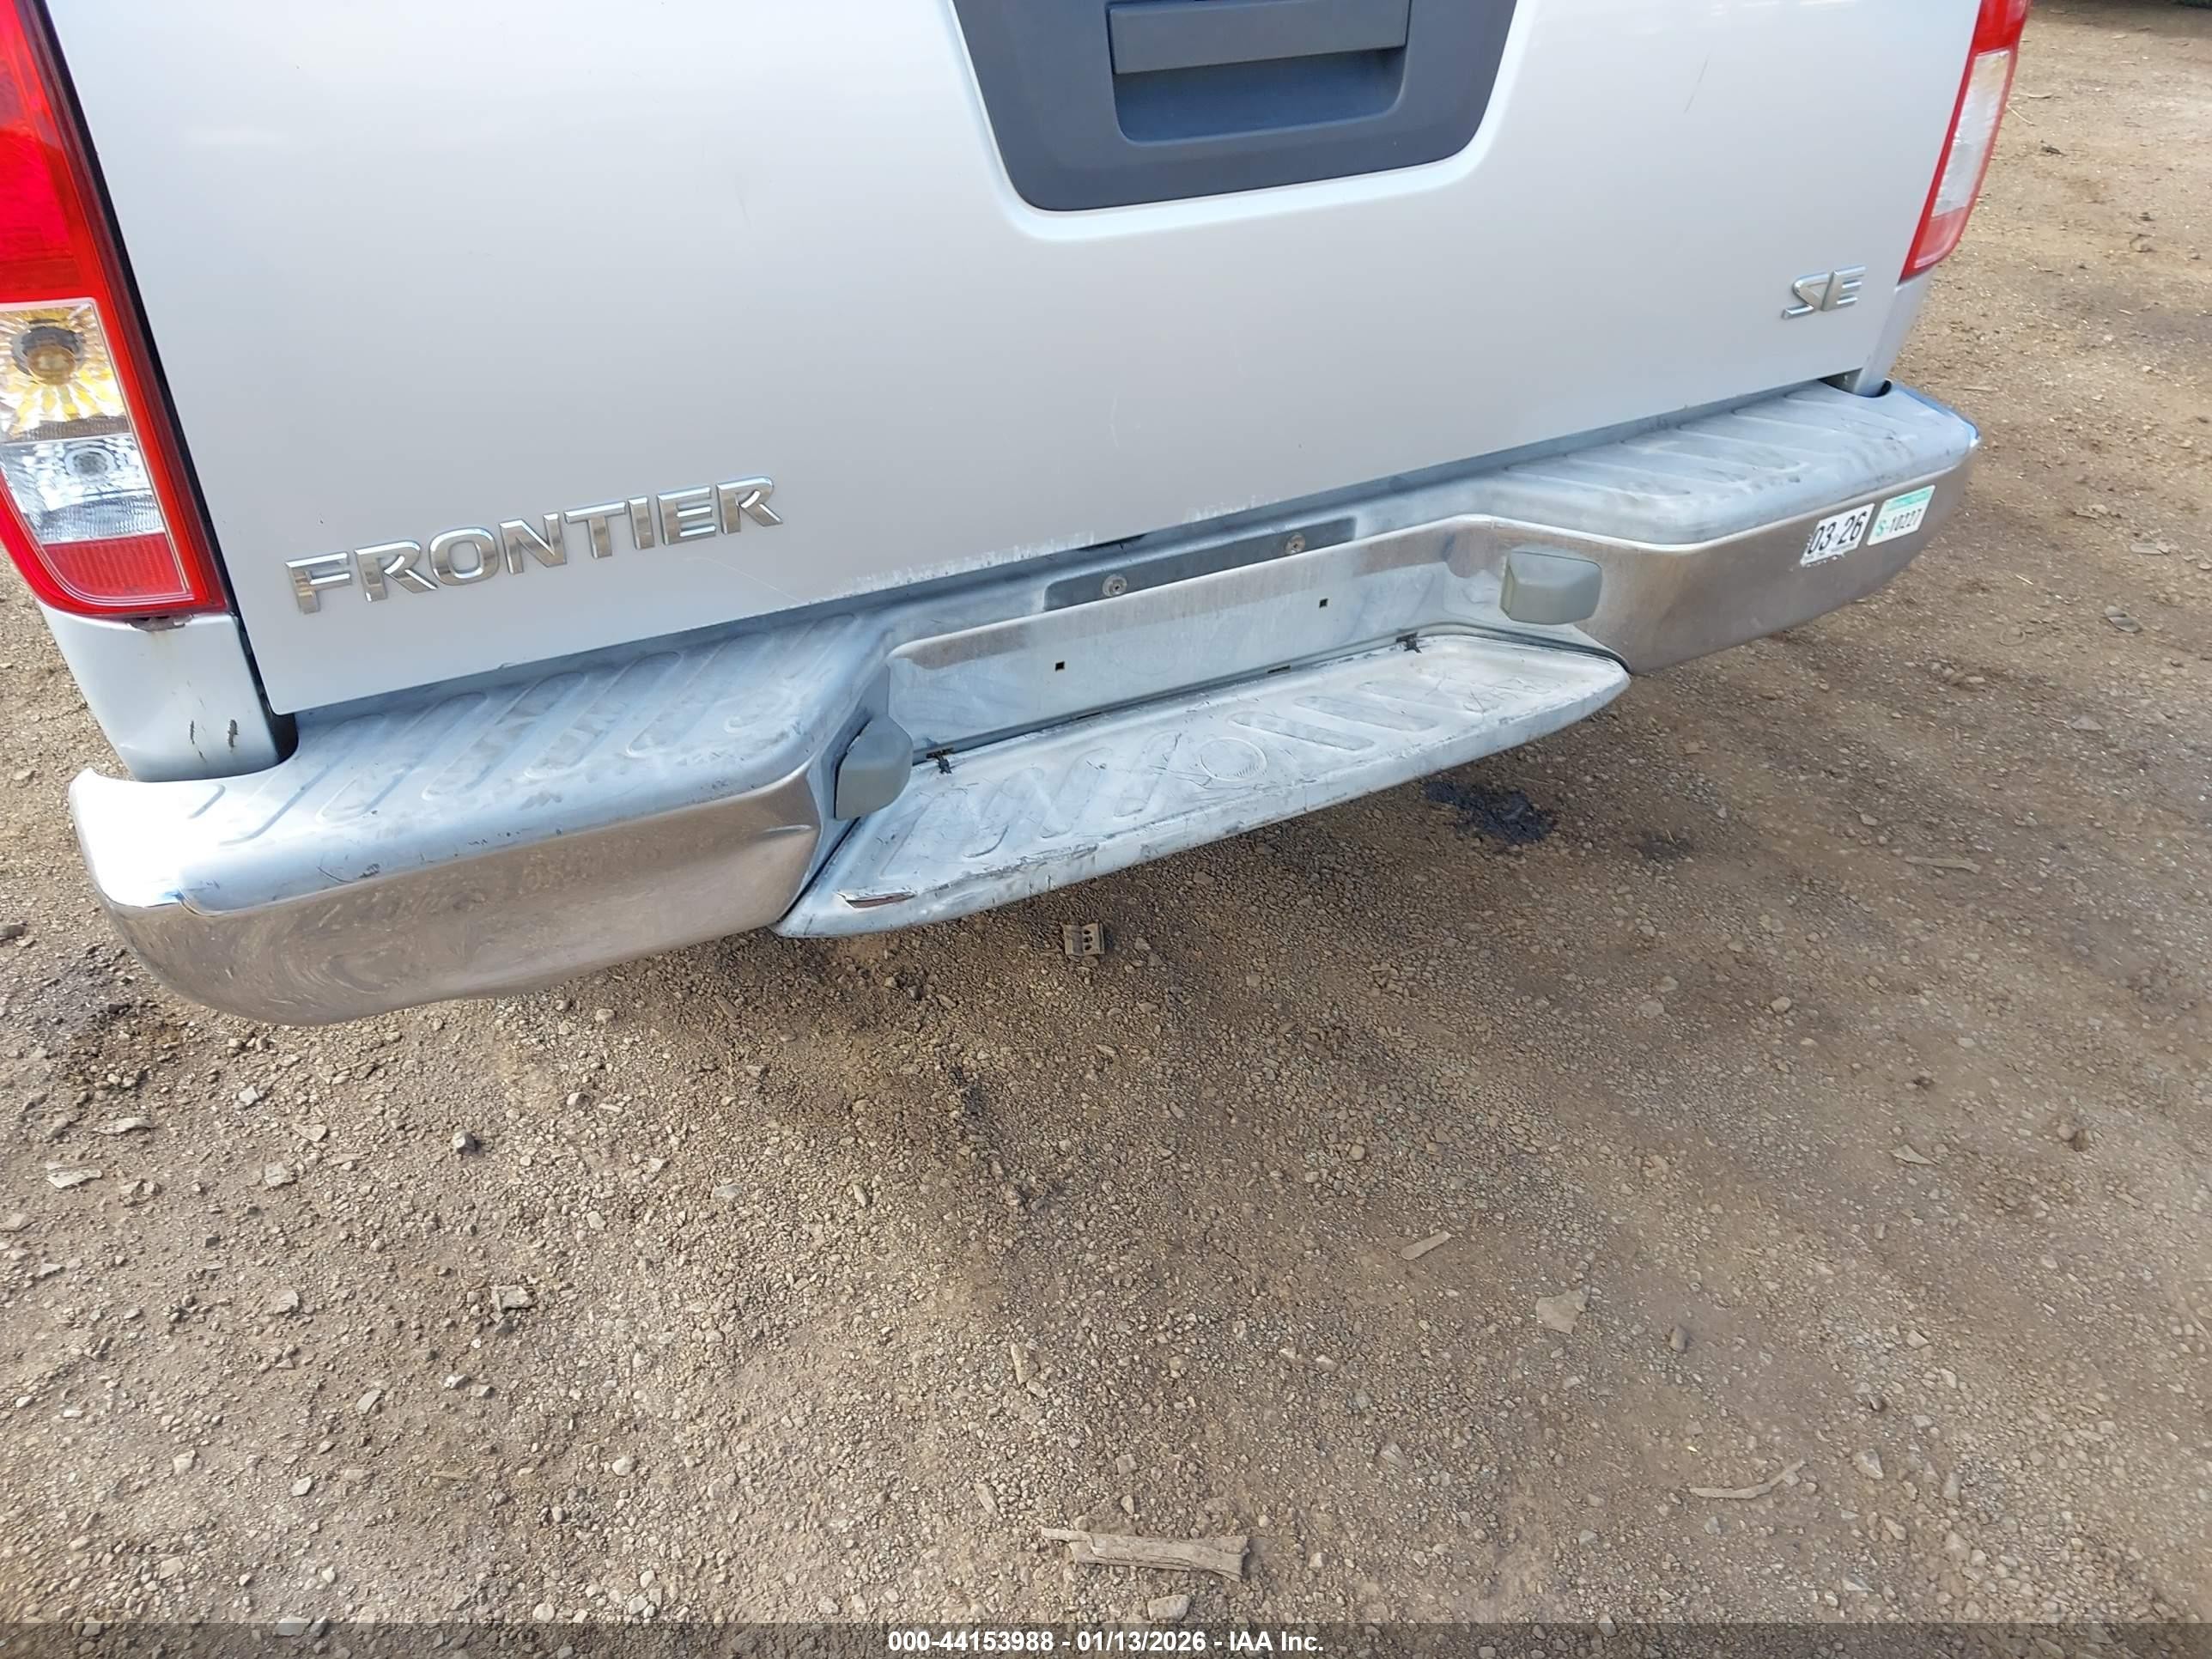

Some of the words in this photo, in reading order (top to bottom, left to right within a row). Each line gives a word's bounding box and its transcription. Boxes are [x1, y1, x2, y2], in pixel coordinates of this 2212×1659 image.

[1781, 264, 1866, 319] SE
[285, 476, 783, 614] FRONTIER
[1807, 522, 1837, 555] 03
[1838, 510, 1868, 545] 26
